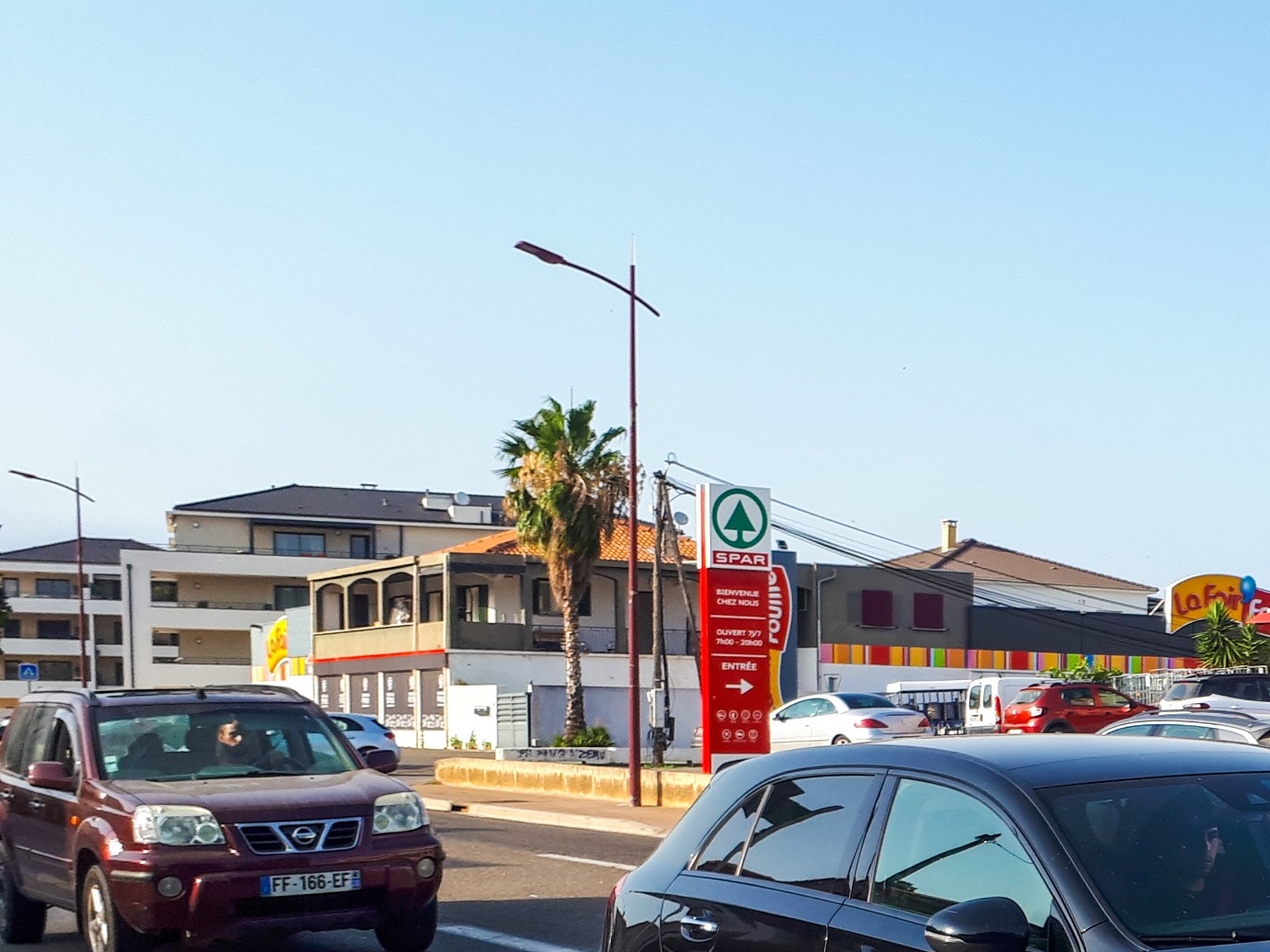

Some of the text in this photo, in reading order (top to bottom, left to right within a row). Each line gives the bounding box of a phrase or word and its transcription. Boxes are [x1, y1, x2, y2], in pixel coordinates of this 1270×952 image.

[716, 553, 765, 565] SPAR
[716, 589, 760, 597] BIENVENUE
[717, 598, 760, 607] CHEZ NOUS
[1174, 592, 1202, 615] La
[716, 629, 747, 637] OUVERT
[740, 638, 763, 647] 20h00
[721, 661, 758, 671] ENTRÉE
[272, 872, 350, 892] FF-166-EF
